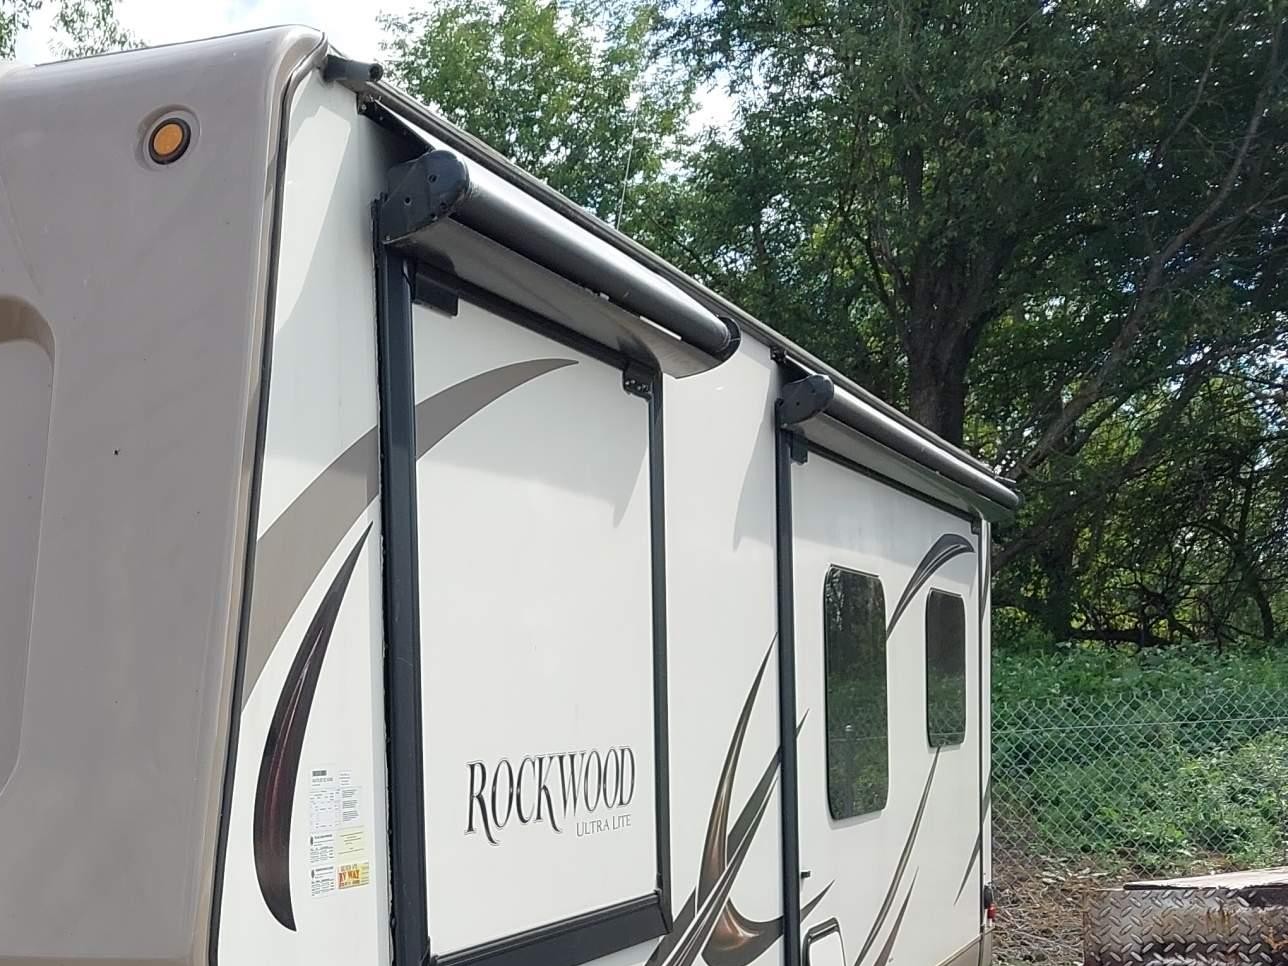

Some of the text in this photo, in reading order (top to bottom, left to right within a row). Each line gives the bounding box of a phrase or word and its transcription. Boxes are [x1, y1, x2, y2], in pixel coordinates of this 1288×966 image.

[465, 746, 636, 847] ROCKWOOD
[576, 814, 632, 837] ULTRA LITE
